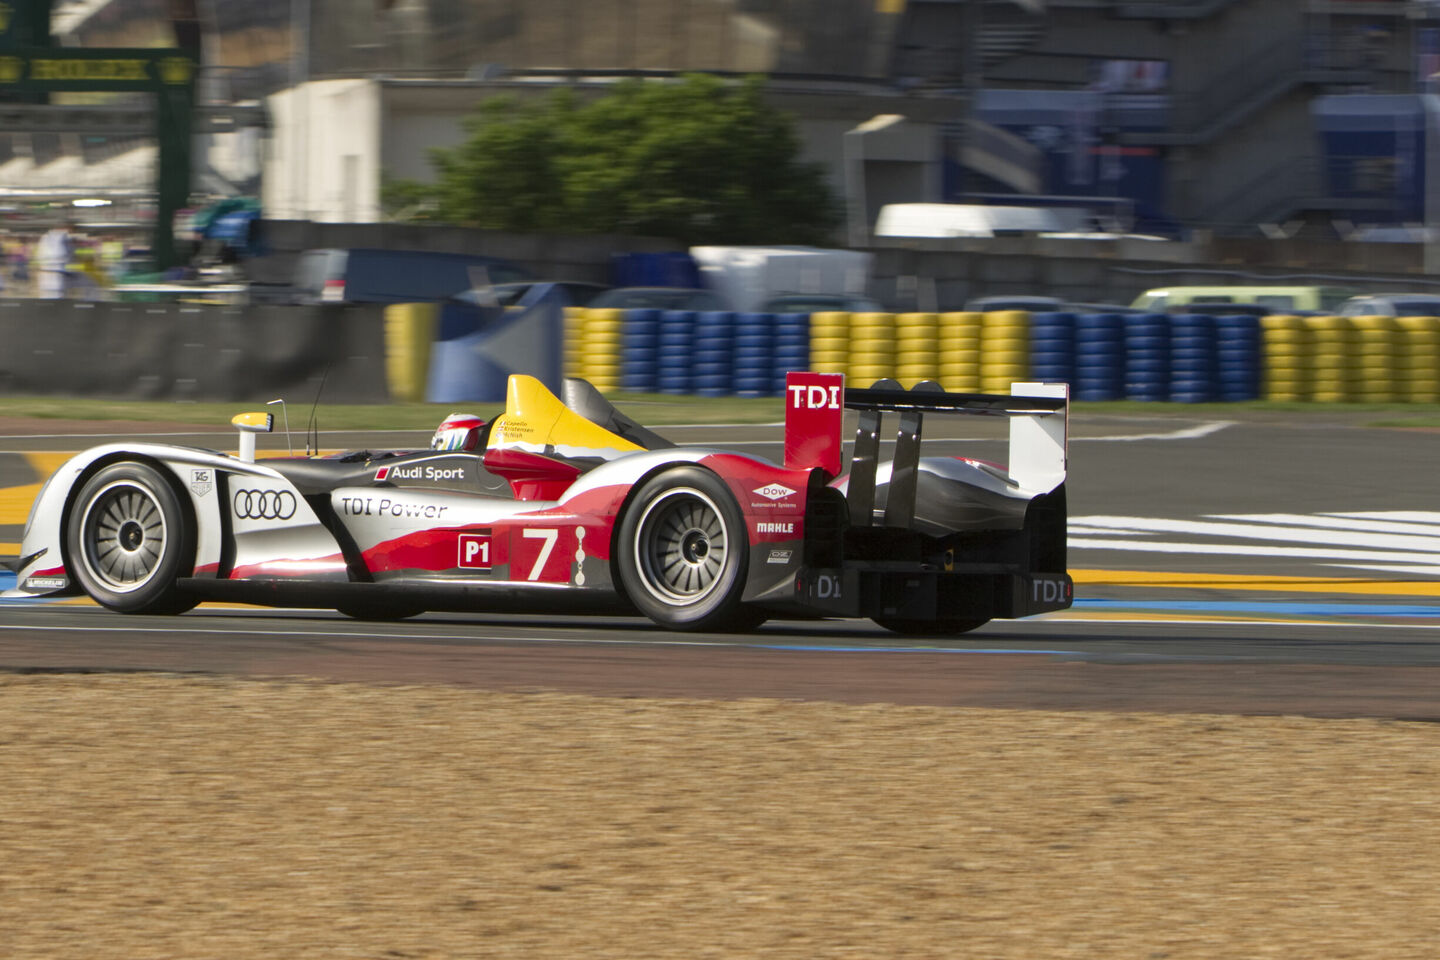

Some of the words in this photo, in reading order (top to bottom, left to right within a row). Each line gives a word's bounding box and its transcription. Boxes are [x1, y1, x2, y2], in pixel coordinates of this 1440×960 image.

[788, 385, 840, 409] TDI
[194, 471, 209, 482] TAG
[391, 467, 422, 479] Audi
[425, 467, 464, 481] Sport
[342, 497, 372, 516] TDI
[379, 499, 448, 519] Power
[757, 522, 794, 533] MAHLE
[465, 540, 489, 562] P1
[523, 528, 558, 580] 7
[1033, 580, 1066, 602] TDI
